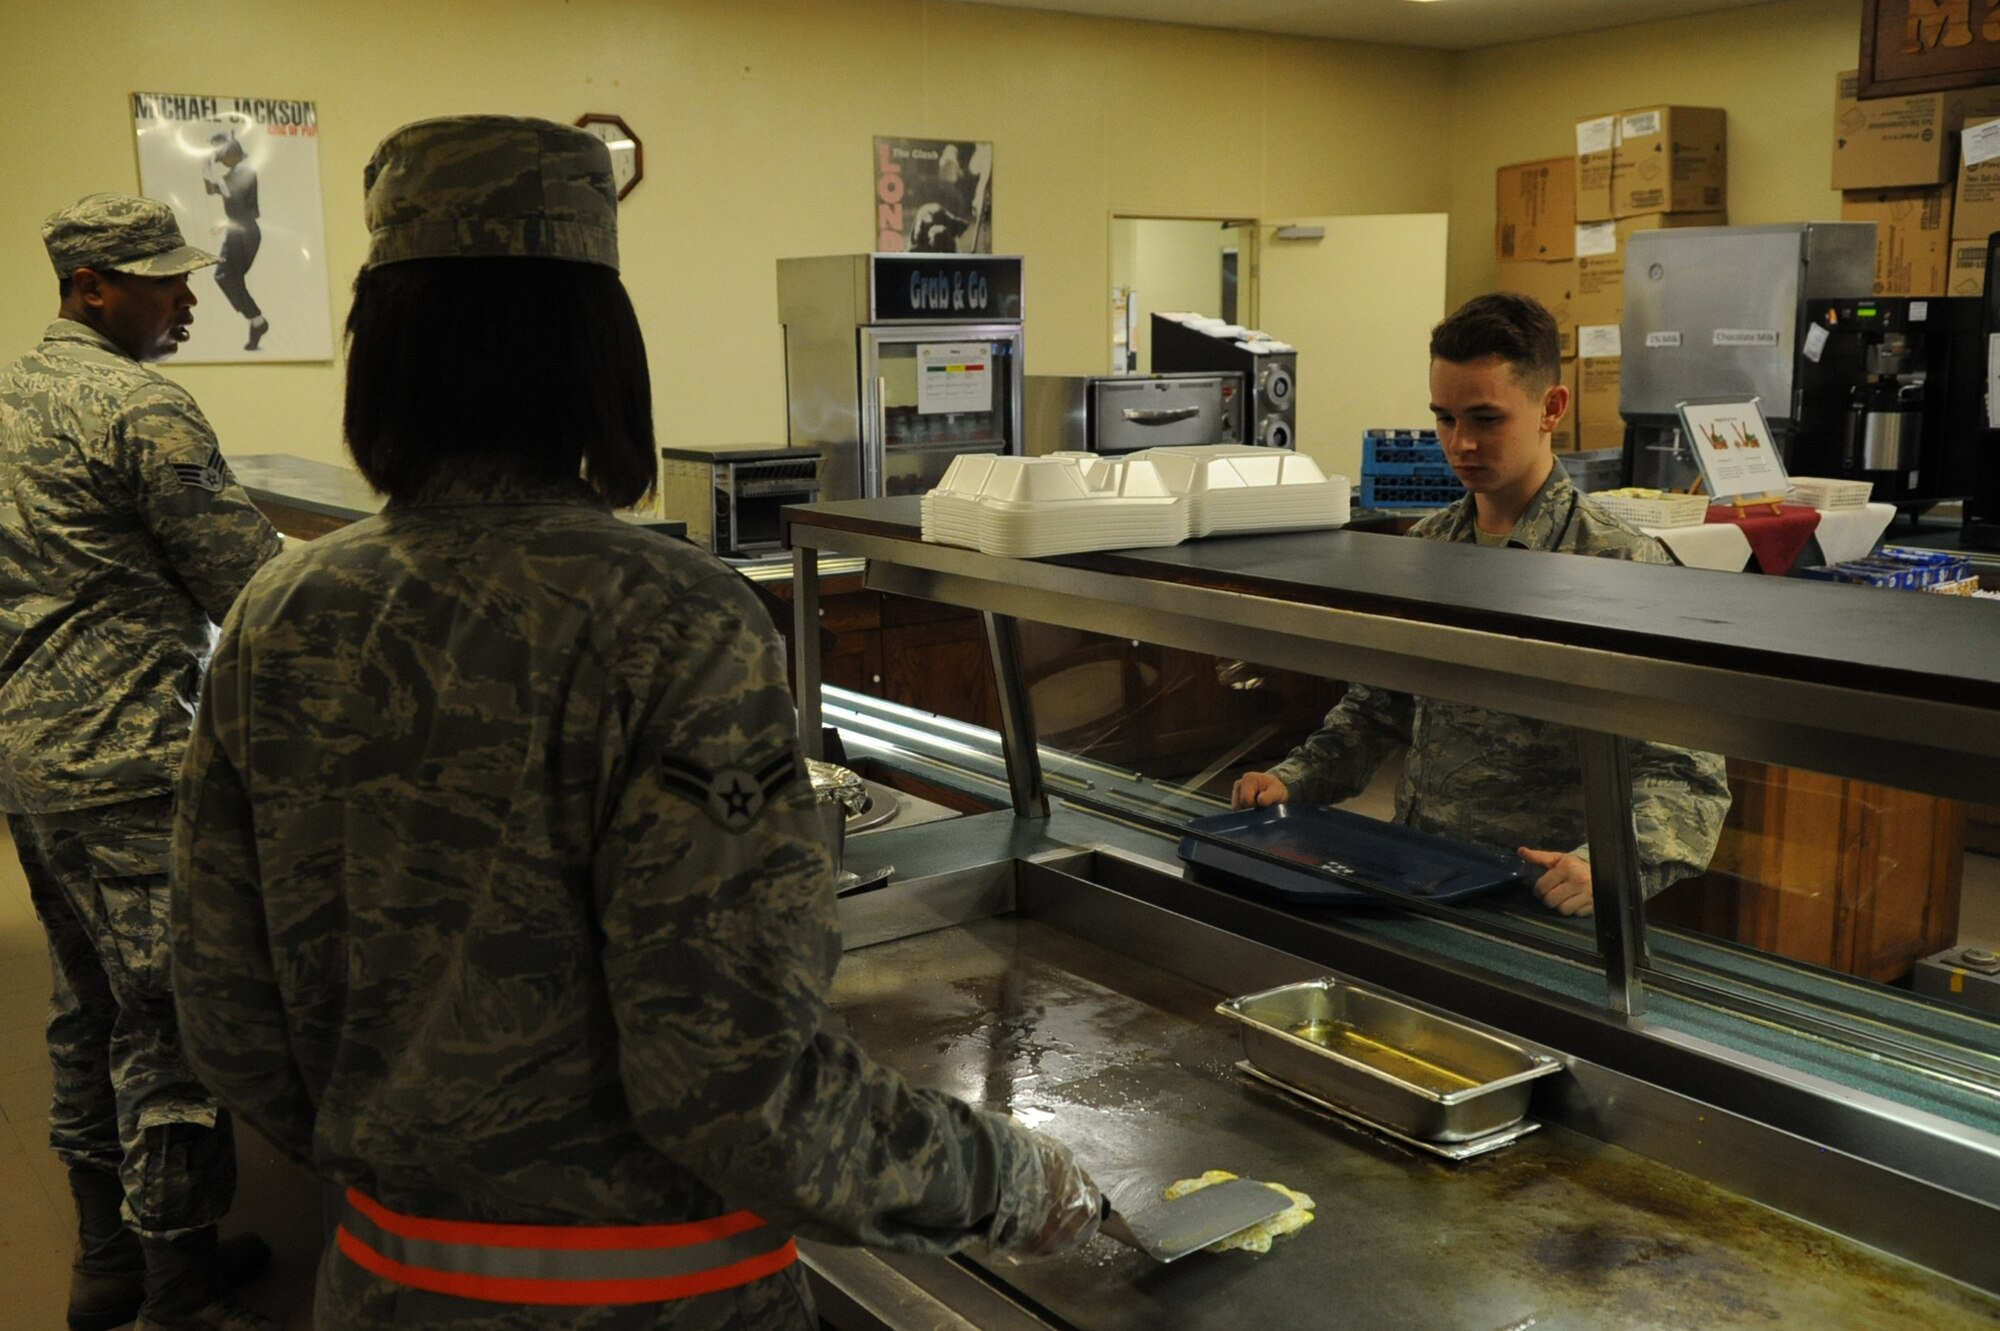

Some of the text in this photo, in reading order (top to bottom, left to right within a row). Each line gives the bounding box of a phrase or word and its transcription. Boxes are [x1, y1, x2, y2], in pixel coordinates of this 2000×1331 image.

[134, 93, 316, 126] MICHAEL JACKSON
[893, 148, 938, 160] The Clash
[910, 270, 988, 310] Grab & Go
